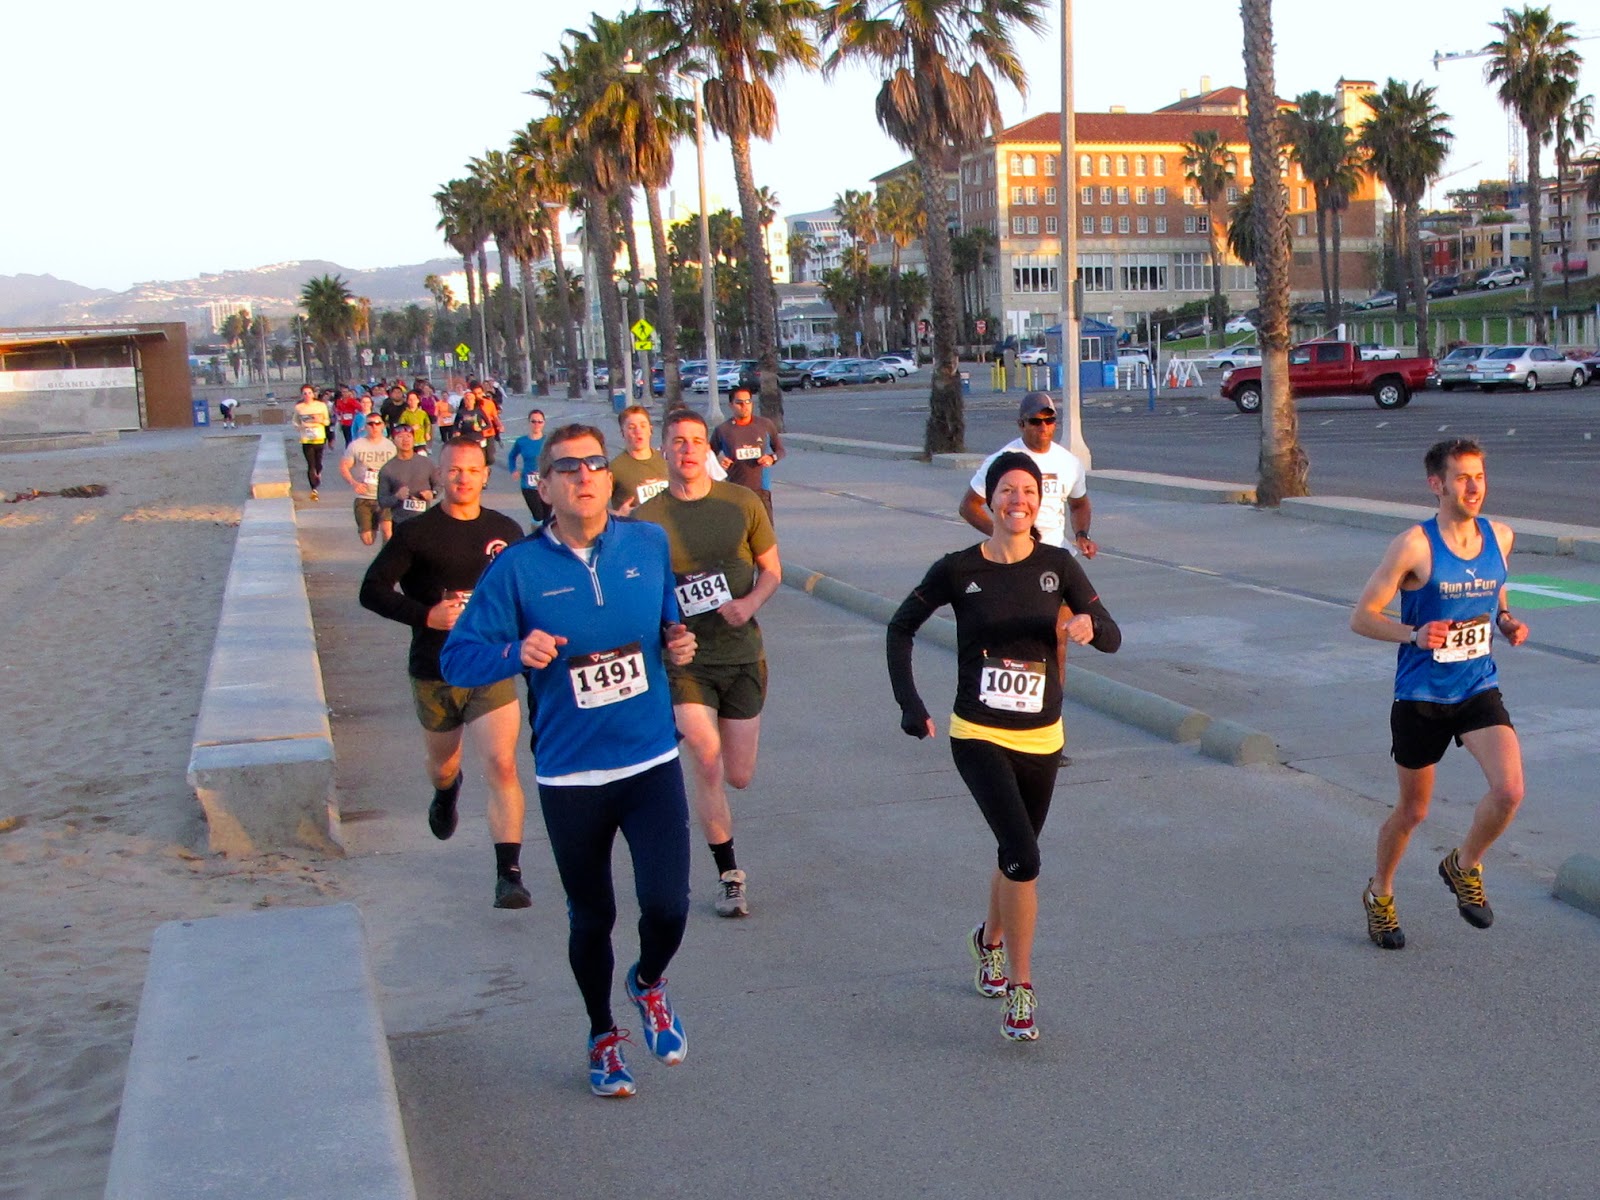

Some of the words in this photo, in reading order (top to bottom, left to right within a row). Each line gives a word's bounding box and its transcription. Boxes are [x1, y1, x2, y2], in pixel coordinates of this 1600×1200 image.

[680, 575, 729, 604] 1484
[1440, 582, 1462, 593] Run
[1474, 579, 1496, 590] Fun
[578, 656, 640, 692] 1491
[986, 670, 1041, 696] 1007
